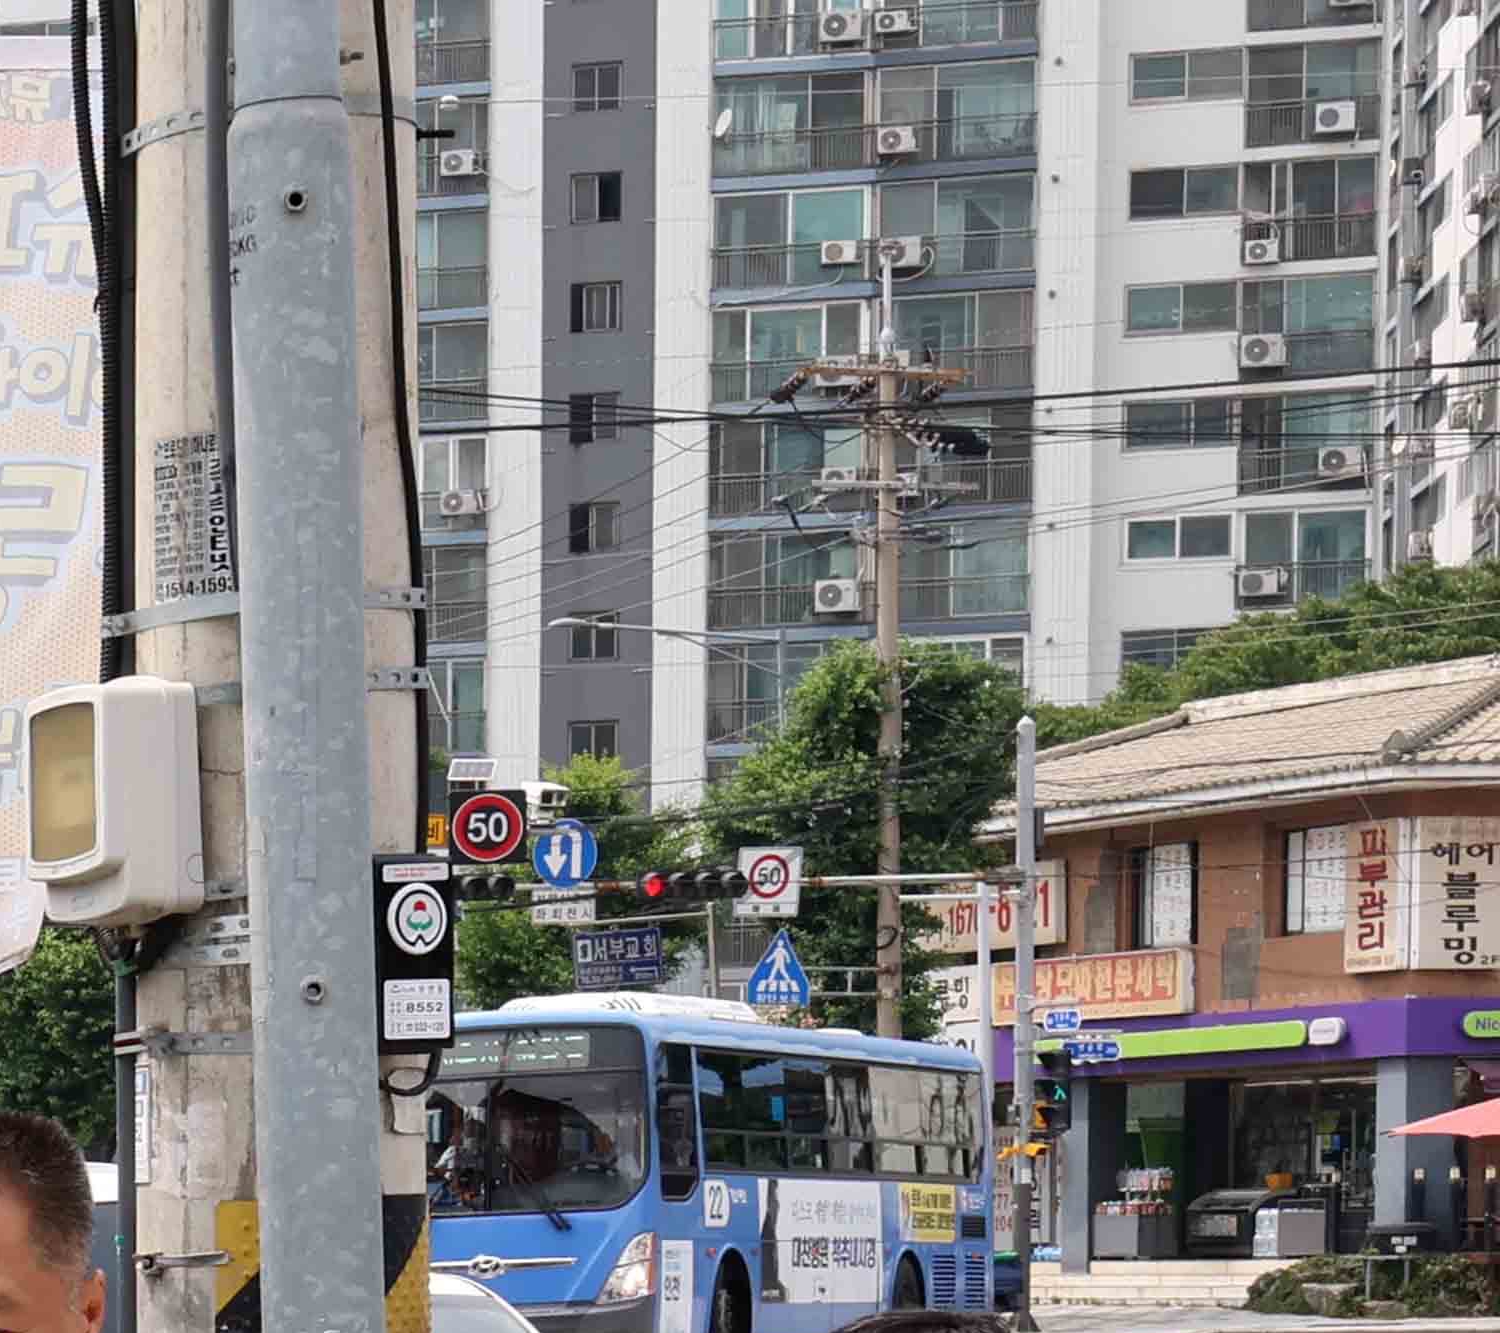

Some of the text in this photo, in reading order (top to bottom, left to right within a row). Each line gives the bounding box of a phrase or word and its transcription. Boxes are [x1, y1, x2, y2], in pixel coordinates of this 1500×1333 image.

[467, 812, 509, 843] 50
[1431, 842, 1495, 866] 헤어
[757, 866, 782, 887] 50
[1357, 828, 1389, 951] 피부관리
[1441, 871, 1481, 965] 블루밍
[406, 1001, 444, 1013] 8552
[709, 1185, 723, 1219] 22
